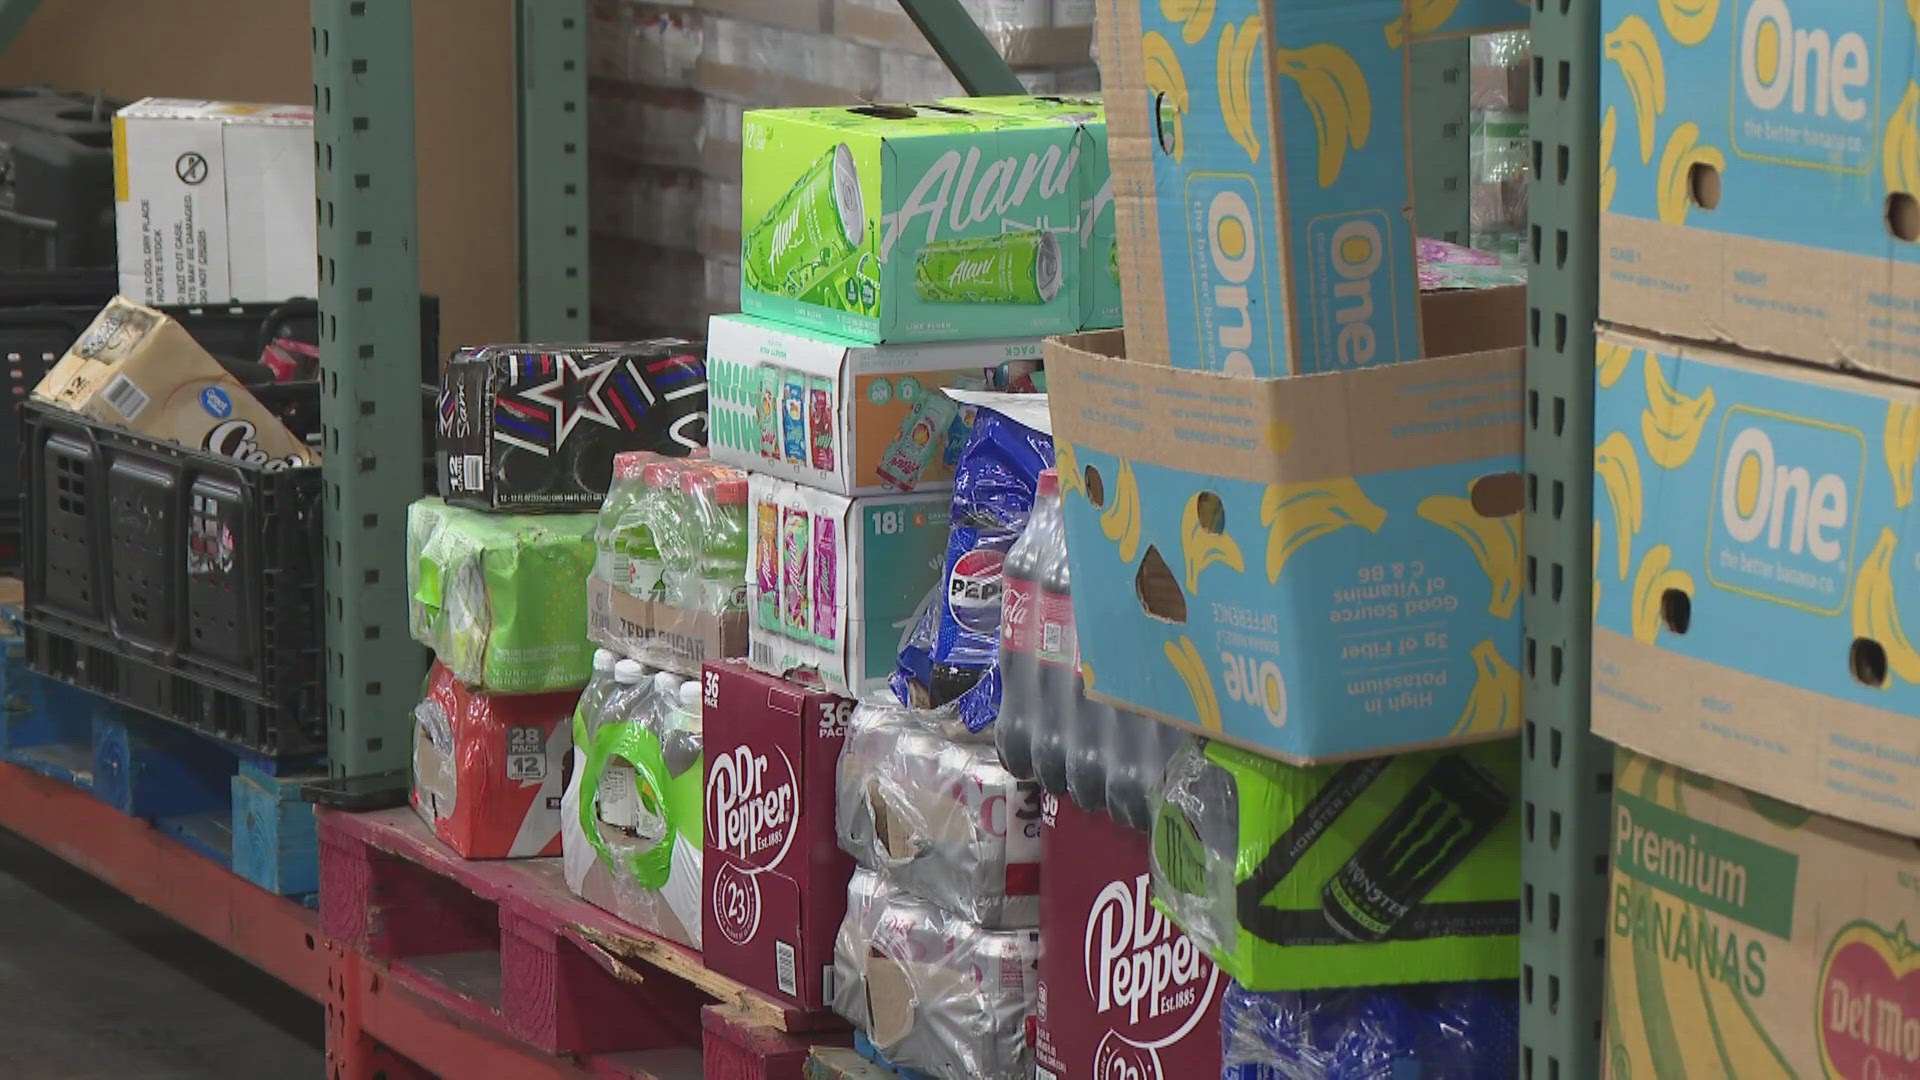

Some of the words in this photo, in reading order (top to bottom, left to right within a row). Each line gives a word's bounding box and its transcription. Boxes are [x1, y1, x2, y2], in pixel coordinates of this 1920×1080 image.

[1742, 0, 1869, 122] One
[141, 198, 150, 232] PLACE
[881, 145, 1080, 264] Alani
[153, 229, 163, 263] STOCK
[155, 264, 164, 302] ROTATE
[1331, 220, 1382, 364] One
[1005, 346, 1037, 357] PACK
[1721, 428, 1848, 563] One
[872, 510, 897, 535] 18
[1358, 565, 1384, 583] B6
[1411, 561, 1424, 579] C
[951, 578, 1002, 600] PEP
[1333, 580, 1420, 604] Vitamins
[1426, 576, 1446, 593] of
[1211, 602, 1279, 635] DIFFERENCE
[1329, 602, 1399, 624] Source
[1405, 594, 1458, 618] Good
[1340, 640, 1392, 659] Fiber
[1399, 638, 1418, 655] of
[1424, 631, 1448, 650] 3g
[705, 671, 719, 697] 36
[1219, 650, 1288, 729] One
[1347, 671, 1447, 697] Potassium
[704, 695, 718, 708] PACK
[1364, 698, 1382, 716] in
[1387, 690, 1433, 713] High
[819, 702, 849, 727] 36
[511, 744, 540, 753] PACK
[512, 728, 540, 745] 28
[513, 757, 539, 773] 12
[735, 745, 768, 802] Dr
[707, 753, 791, 860] Pepper
[1616, 804, 1747, 908] Premium
[728, 881, 745, 924] 23
[1614, 885, 1766, 998] BANANAS
[1830, 979, 1872, 1045] Del
